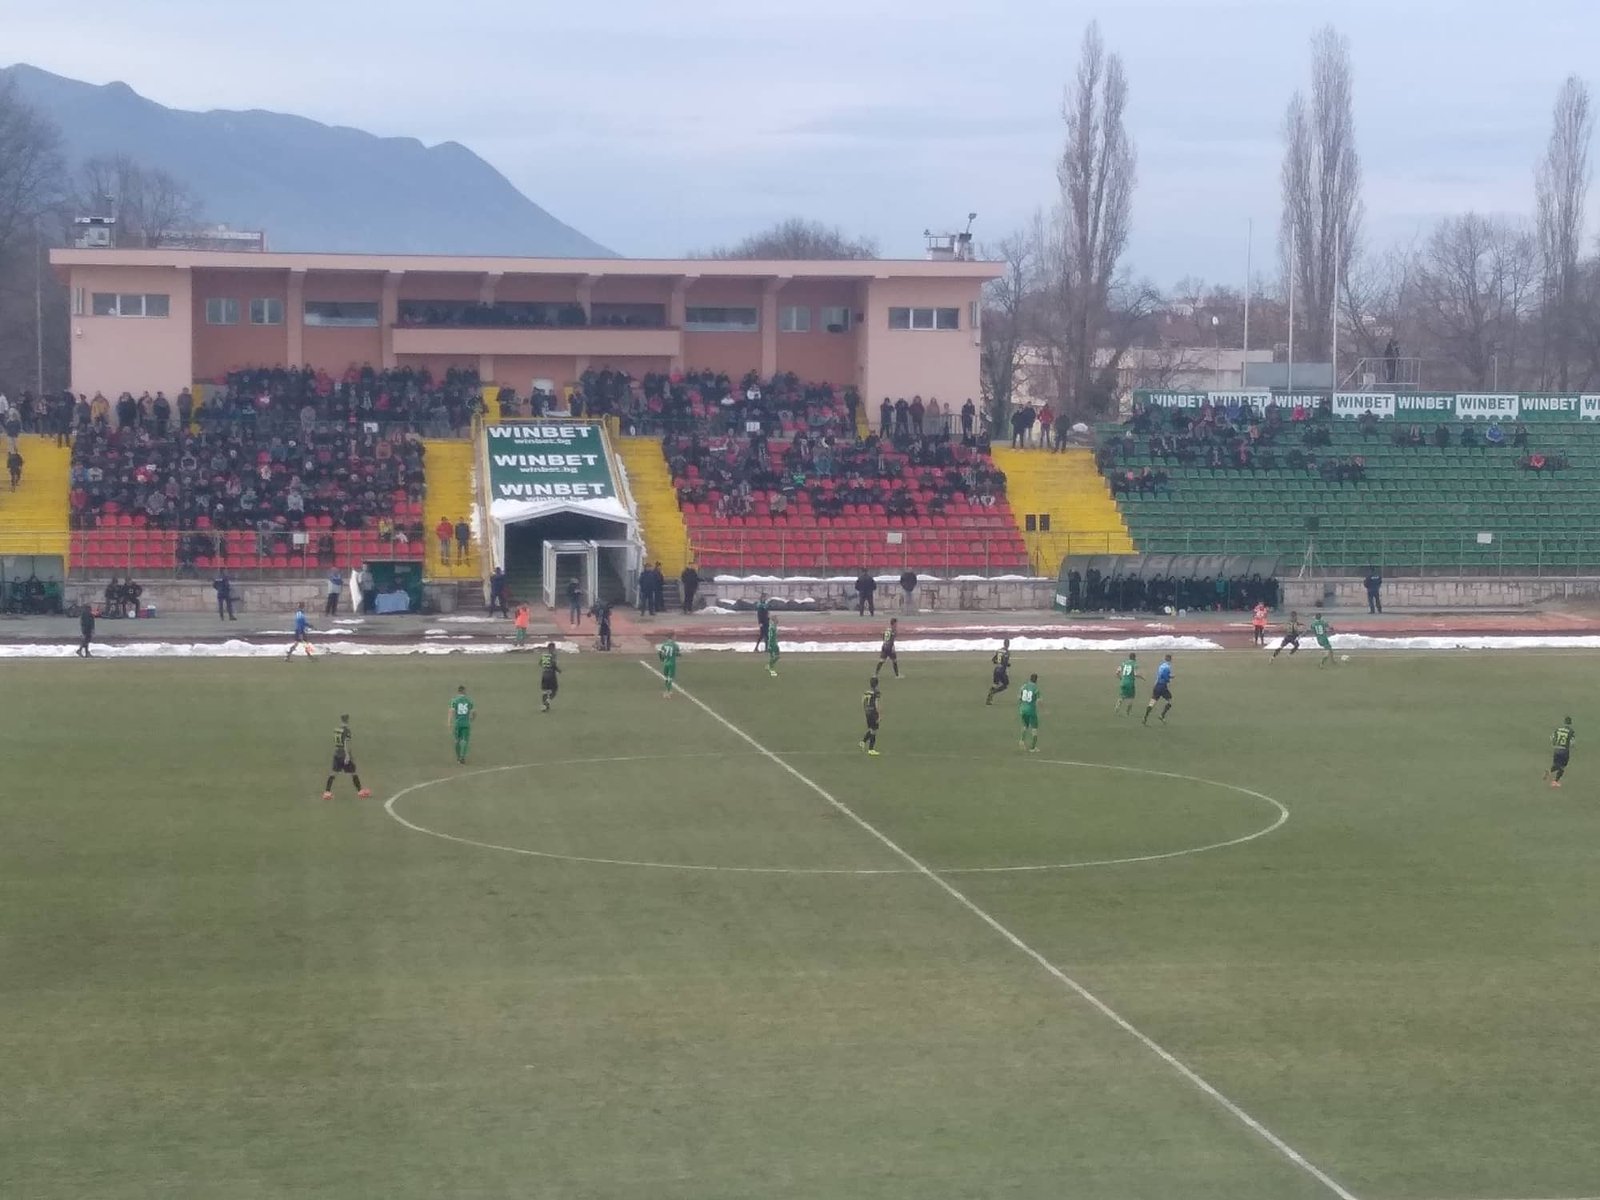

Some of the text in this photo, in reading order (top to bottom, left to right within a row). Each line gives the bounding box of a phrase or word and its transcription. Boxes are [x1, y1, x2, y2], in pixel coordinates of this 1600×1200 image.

[1336, 396, 1392, 409] WINBET
[1398, 396, 1453, 410] WINBET
[1460, 397, 1515, 410] WINBET
[1521, 397, 1578, 411] WINBET
[489, 426, 592, 438] WINBET
[494, 454, 598, 466] WINBET
[500, 483, 605, 495] WINBET
